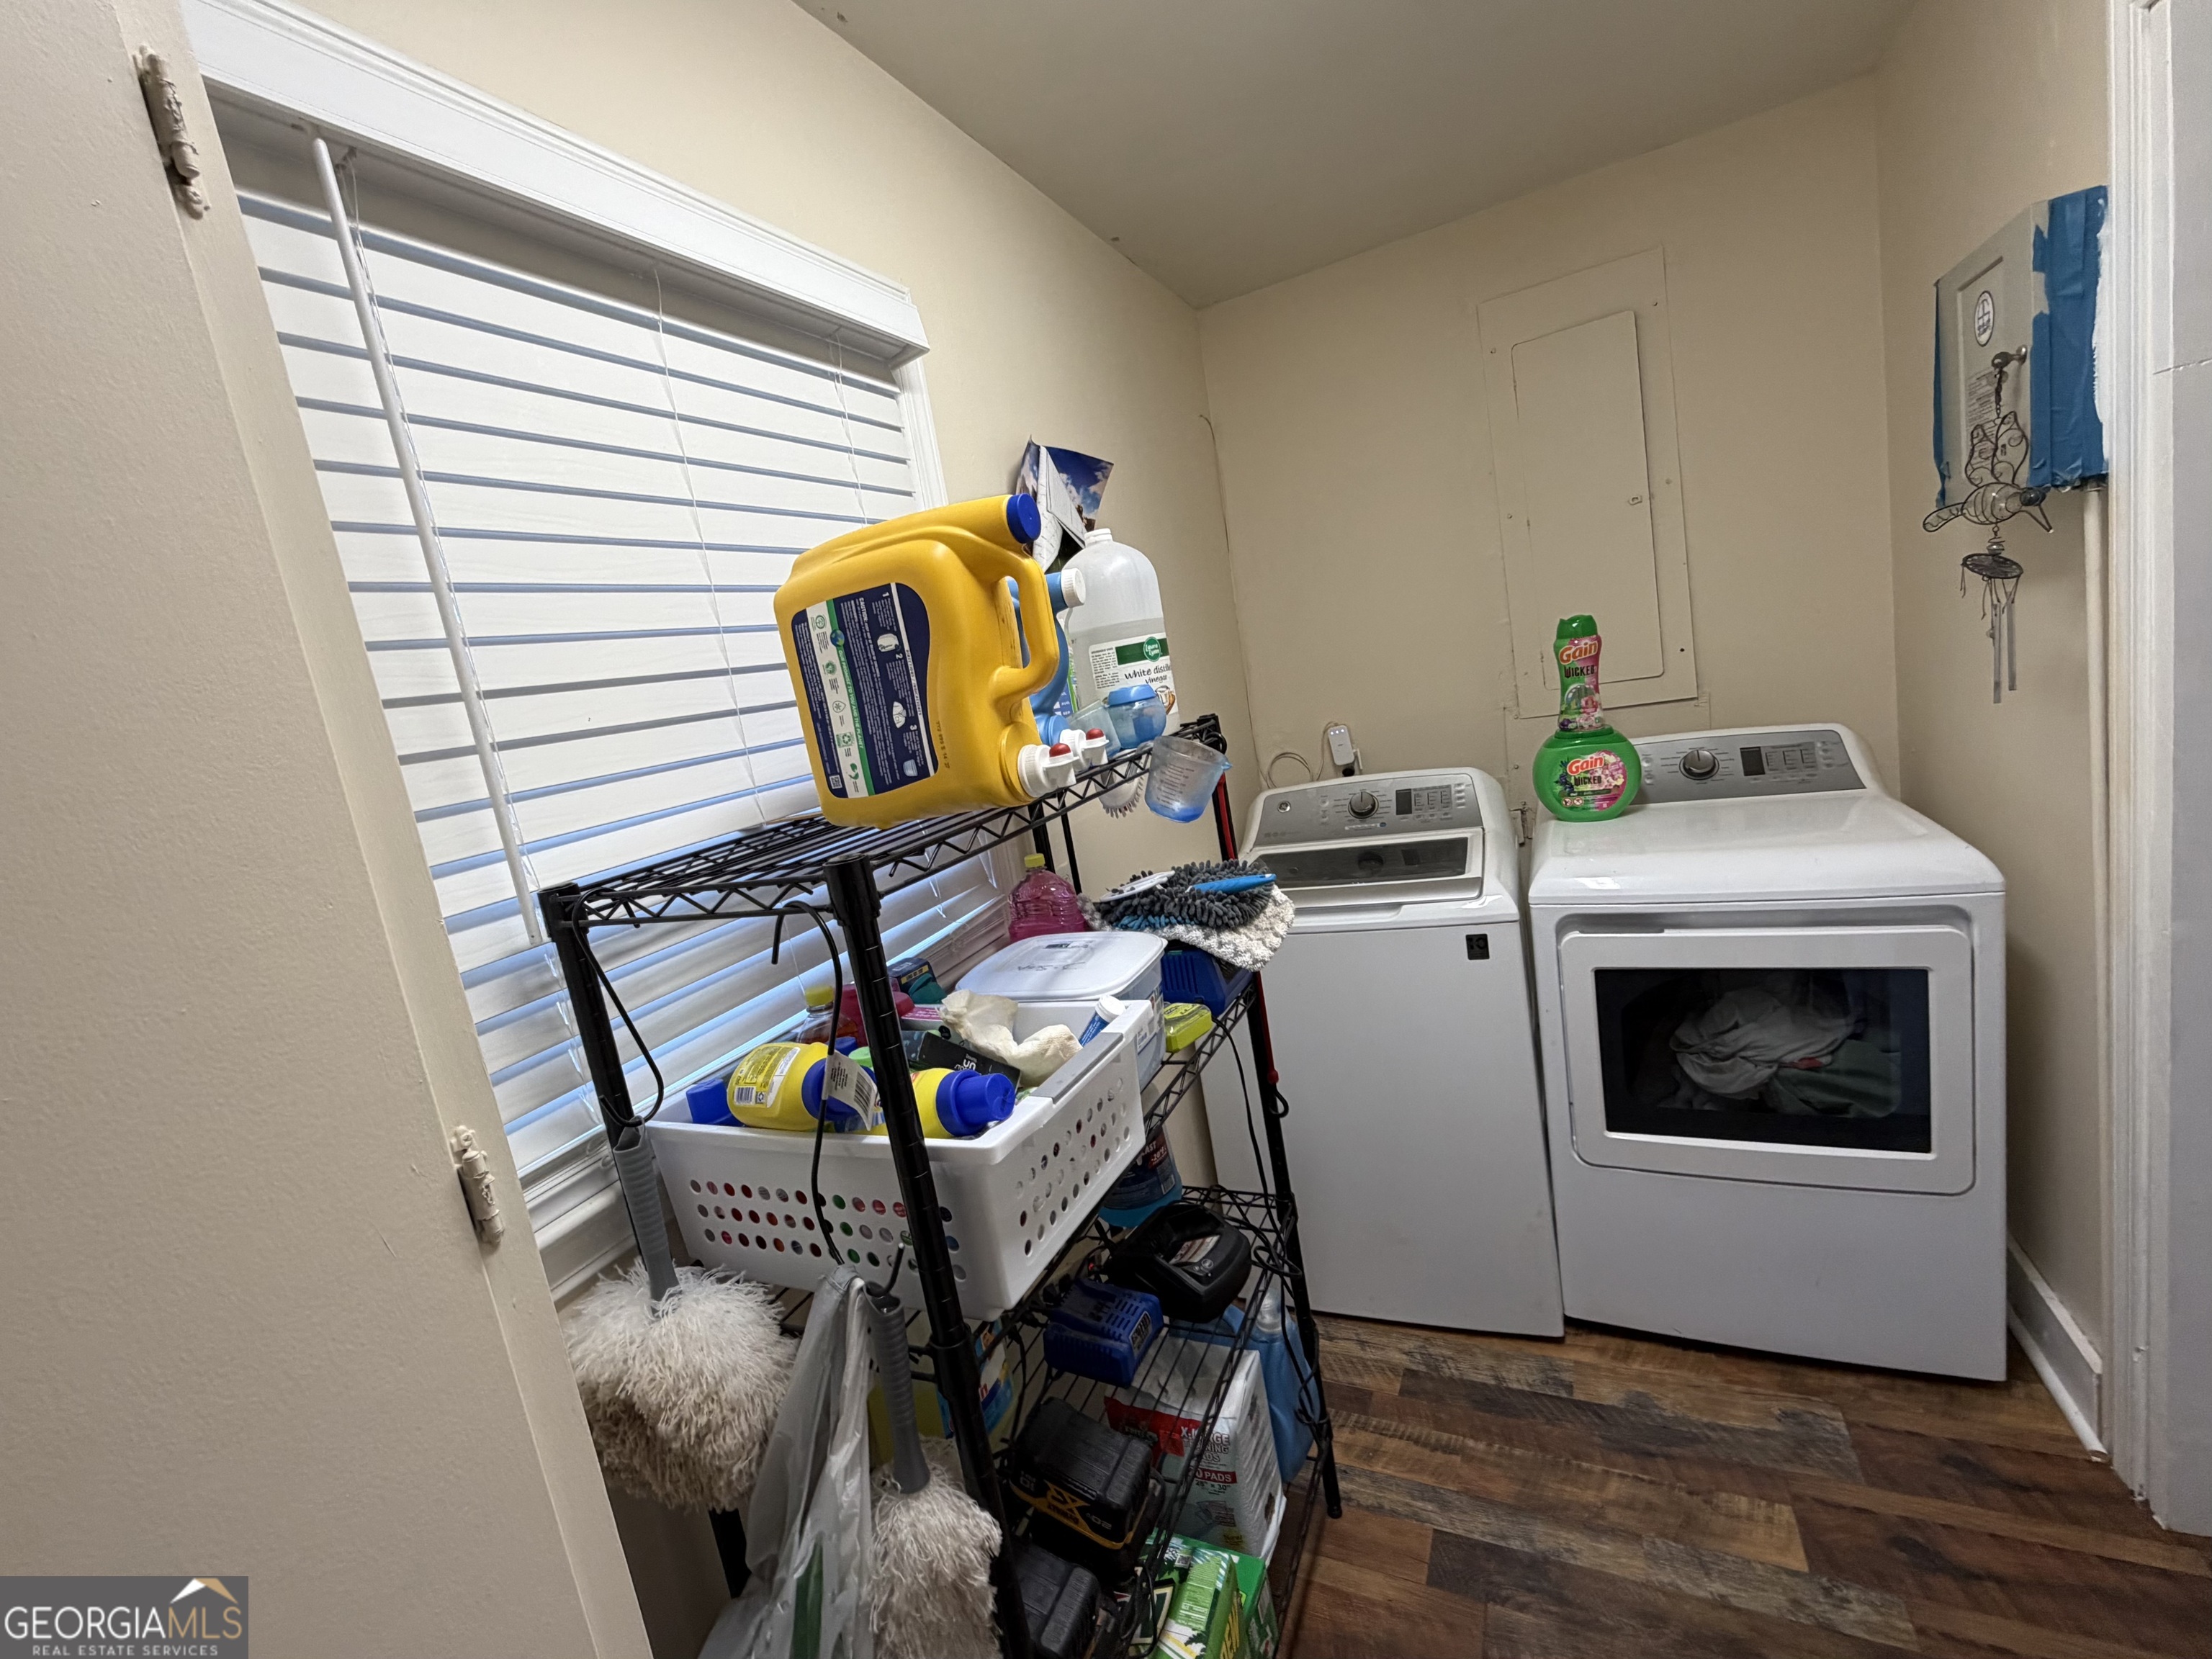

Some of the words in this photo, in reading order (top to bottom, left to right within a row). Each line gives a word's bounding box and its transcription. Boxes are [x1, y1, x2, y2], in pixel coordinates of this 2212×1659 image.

[1559, 640, 1598, 665] Gain
[842, 662, 850, 684] PROMISE
[1125, 668, 1152, 679] white
[1564, 665, 1595, 678] WICKED
[1145, 675, 1167, 685] vinegar
[1568, 756, 1604, 775] Gain
[1574, 775, 1602, 786] WICKED
[1205, 1471, 1232, 1483] PADS
